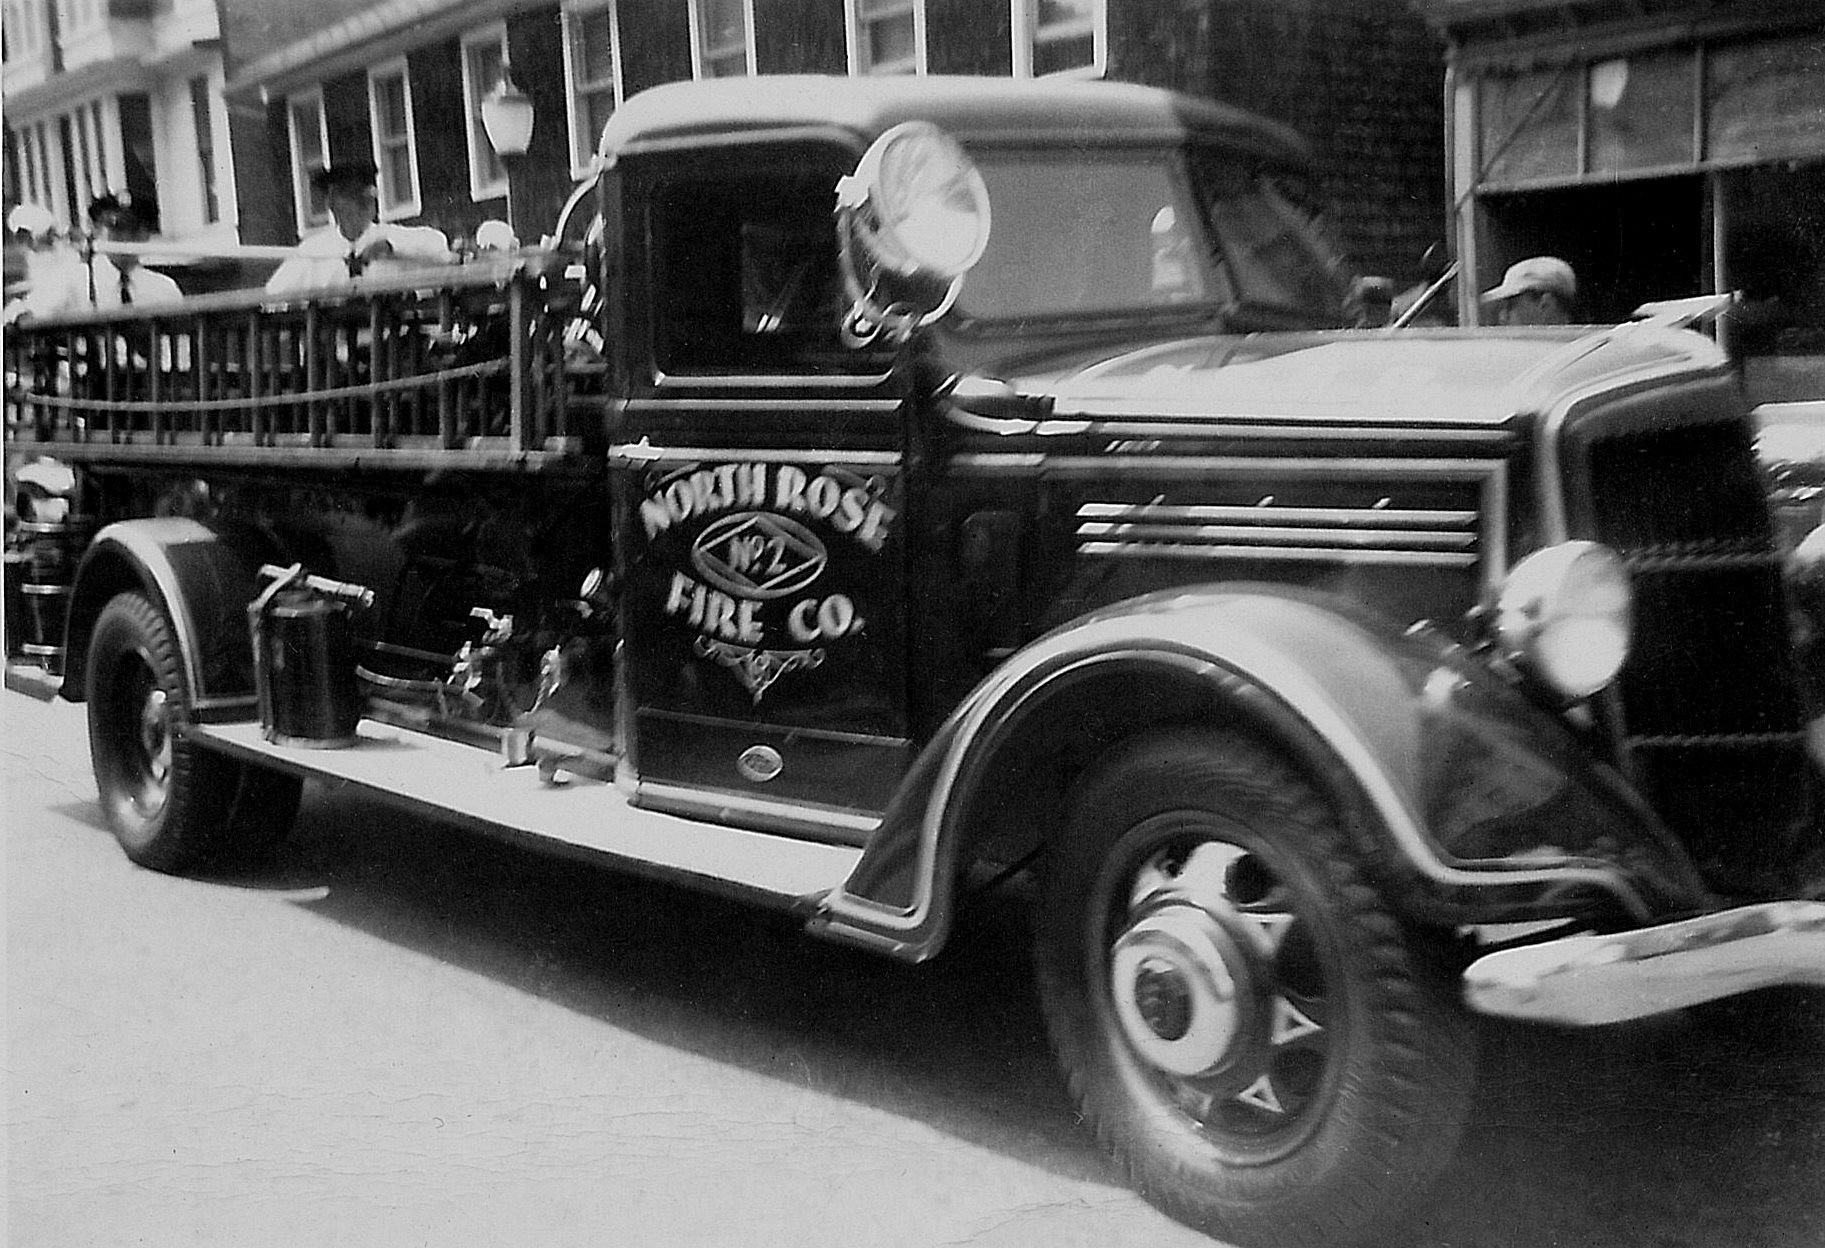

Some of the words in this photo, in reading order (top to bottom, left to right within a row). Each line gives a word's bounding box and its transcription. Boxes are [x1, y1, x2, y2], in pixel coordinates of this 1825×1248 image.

[640, 463, 766, 540] NORTH
[776, 464, 896, 549] ROSE
[667, 570, 764, 643] FIRE
[788, 594, 865, 642] CO.
